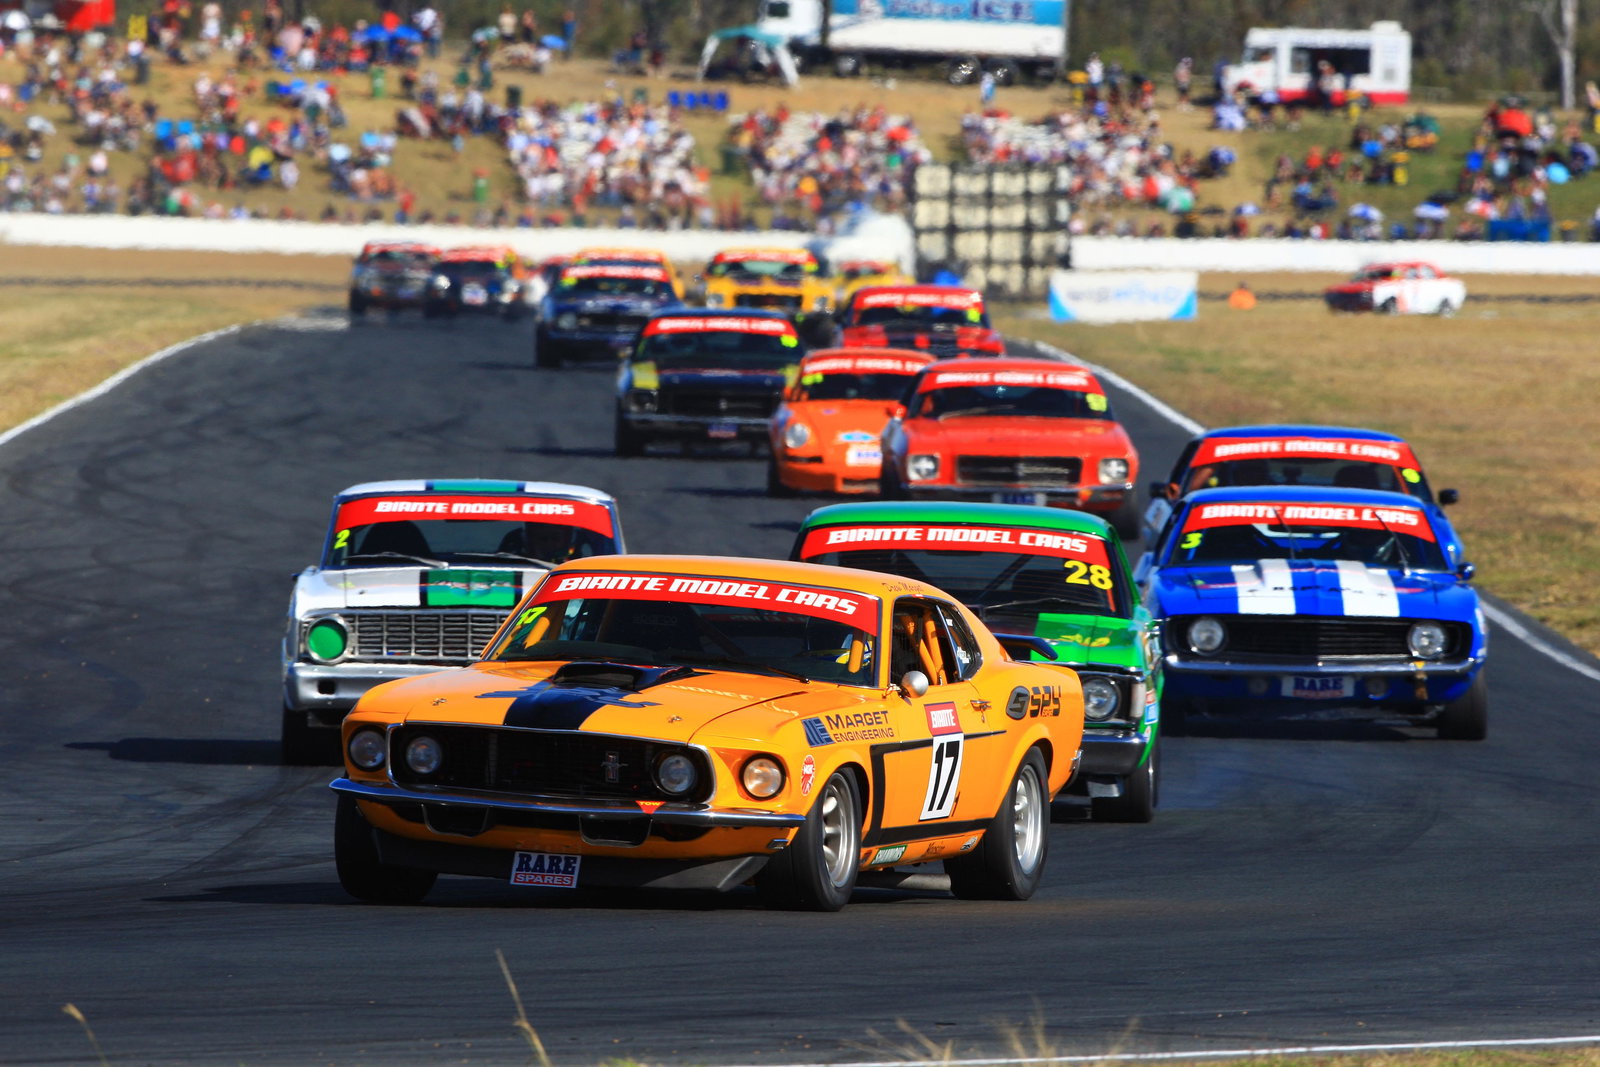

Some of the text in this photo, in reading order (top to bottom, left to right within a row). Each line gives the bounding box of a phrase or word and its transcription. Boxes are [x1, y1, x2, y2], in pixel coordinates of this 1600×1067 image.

[374, 500, 575, 516] BIANTE MODEL CARS
[1201, 506, 1418, 526] BIANTE MODEL CARS
[334, 529, 350, 550] 2
[826, 528, 1088, 553] BIANTE MODEL CARS
[1181, 532, 1203, 549] 3
[1063, 560, 1113, 590] 28
[553, 576, 859, 616] BIANTE MODEL CARS
[517, 606, 547, 627] 17
[833, 728, 895, 743] ENGINEERING
[927, 740, 960, 812] 17
[515, 852, 578, 875] RARE
[516, 873, 573, 885] SPARES
